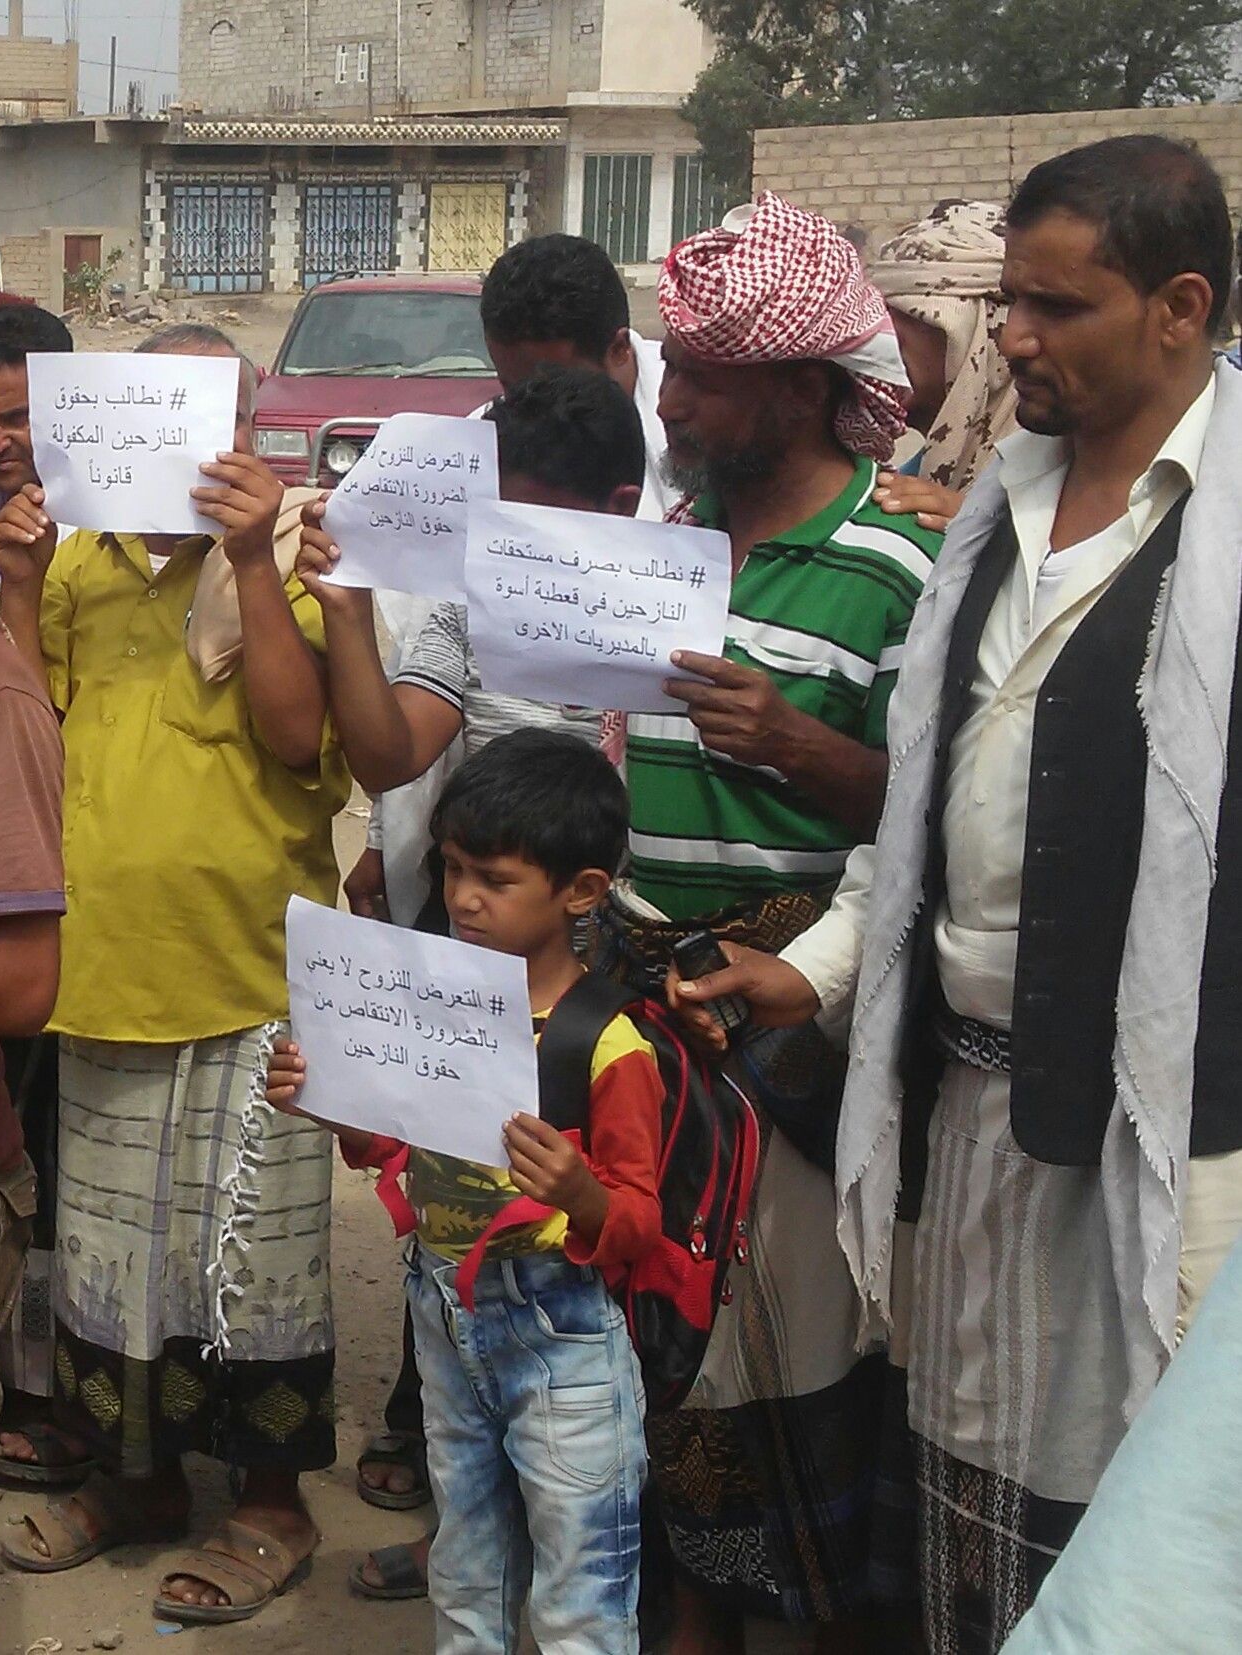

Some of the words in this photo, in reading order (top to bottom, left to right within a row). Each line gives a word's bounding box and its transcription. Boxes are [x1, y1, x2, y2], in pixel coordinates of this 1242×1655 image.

[55, 386, 98, 410] بحقوق
[105, 385, 162, 410] نطالب
[52, 424, 104, 449] المكفولة
[111, 428, 187, 451] النازحين
[378, 446, 413, 468] للنزوح
[417, 452, 464, 472] التعرض
[362, 478, 410, 496] الانتقاص
[369, 511, 414, 530] النازحين
[421, 516, 453, 535] حقوق
[486, 539, 553, 563] مستحقات
[559, 550, 622, 574] بصرف
[628, 559, 684, 582] نطالب
[534, 582, 579, 605] قعطبة
[584, 592, 607, 617] في
[612, 601, 686, 623] النازحين
[574, 629, 657, 658] بالمديريات
[306, 950, 335, 976] يعني
[339, 955, 352, 977] لا
[359, 967, 411, 991] للنزوح
[315, 992, 333, 1011] من
[417, 984, 482, 1009] التعرض
[339, 1000, 408, 1027] الانتقاص
[414, 1014, 498, 1054] بالضرورة
[344, 1037, 408, 1067] النازحين
[415, 1055, 461, 1081] حقوق
